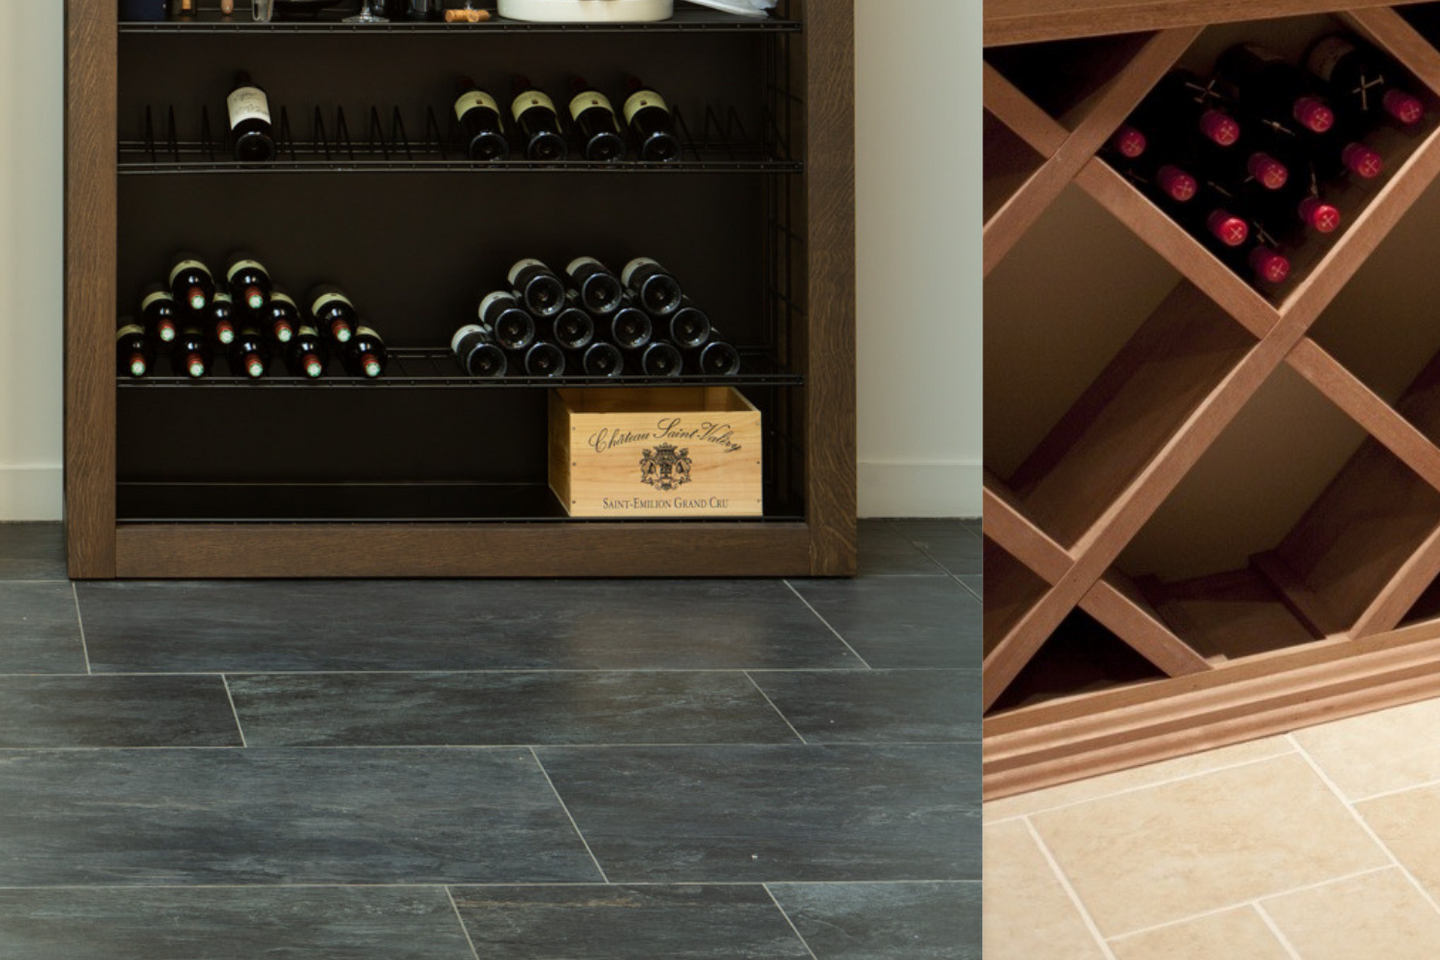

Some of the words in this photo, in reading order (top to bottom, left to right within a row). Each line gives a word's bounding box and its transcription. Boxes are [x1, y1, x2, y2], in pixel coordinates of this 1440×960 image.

[588, 427, 650, 454] Château
[603, 496, 671, 510] SAINT-EMILION
[674, 496, 708, 510] GRAND
[709, 496, 729, 510] CRU
